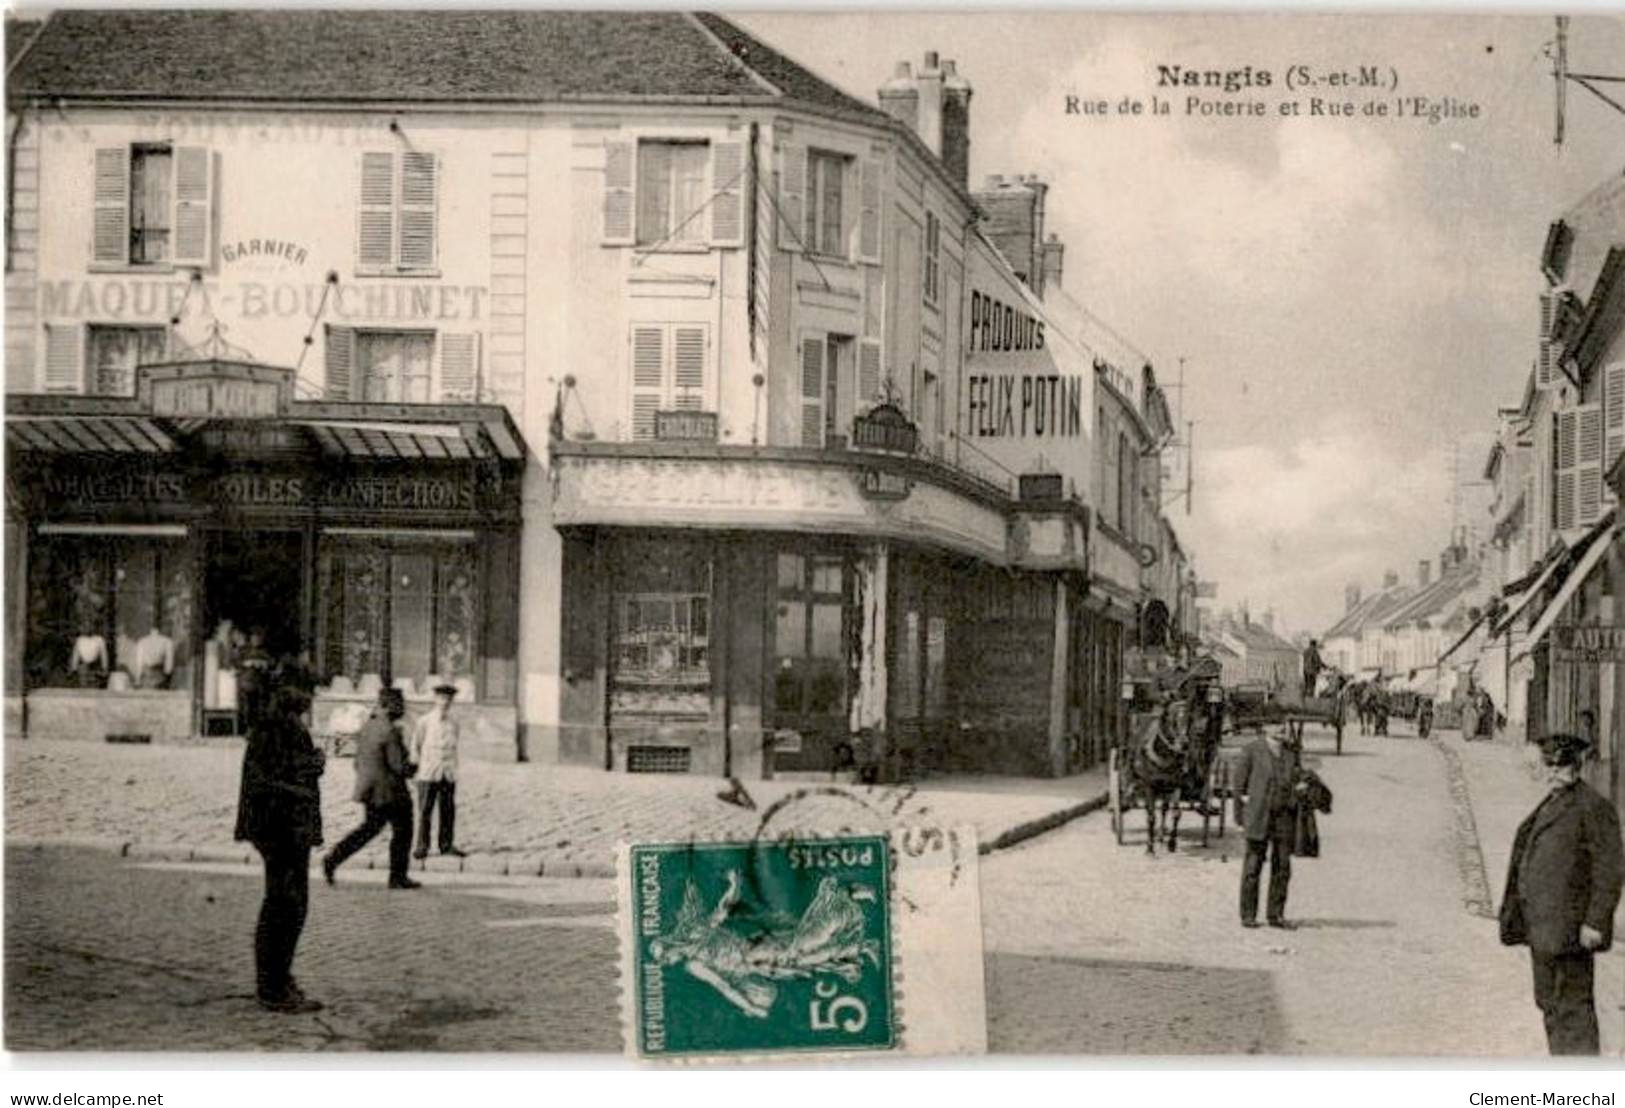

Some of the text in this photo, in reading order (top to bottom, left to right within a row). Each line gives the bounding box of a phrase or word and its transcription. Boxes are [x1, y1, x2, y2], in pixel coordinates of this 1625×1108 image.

[222, 238, 308, 264] GARNIER
[970, 290, 1045, 351] PRODUITS
[968, 376, 1014, 437] FELIX
[1021, 376, 1081, 437] POTIN
[789, 845, 872, 869] POSTES
